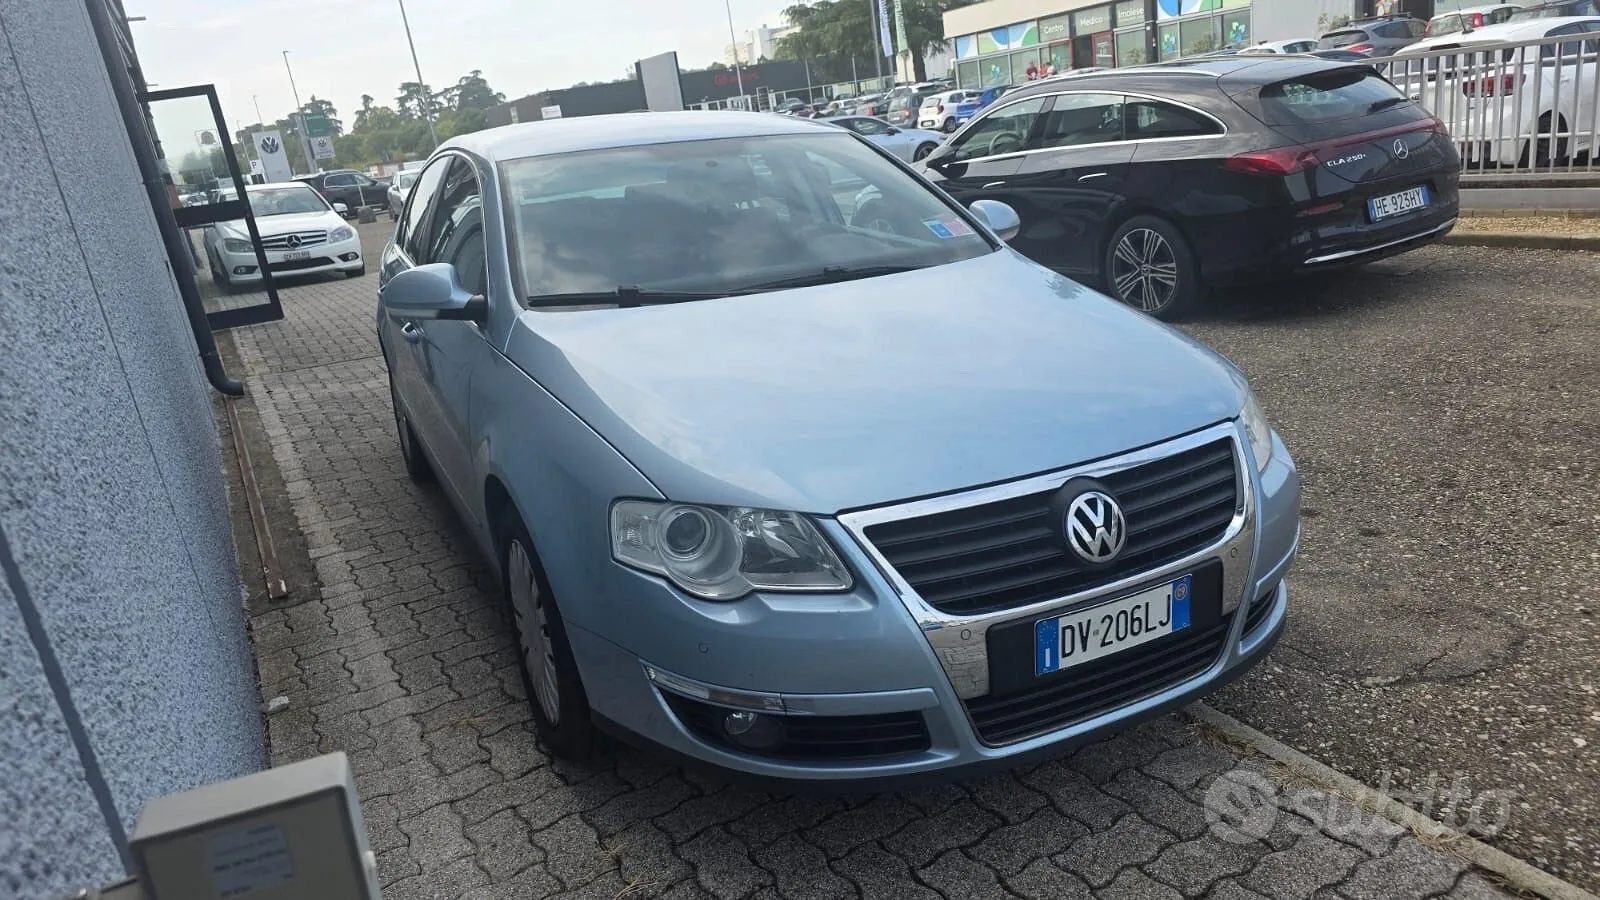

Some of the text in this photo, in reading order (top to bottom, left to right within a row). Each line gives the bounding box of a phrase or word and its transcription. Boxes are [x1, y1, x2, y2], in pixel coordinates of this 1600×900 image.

[1043, 7, 1145, 34] Centro Medico Imolese
[1326, 158, 1346, 167] CLA
[1374, 189, 1425, 218] HE 923HY
[1061, 593, 1171, 658] DV 206LJ
